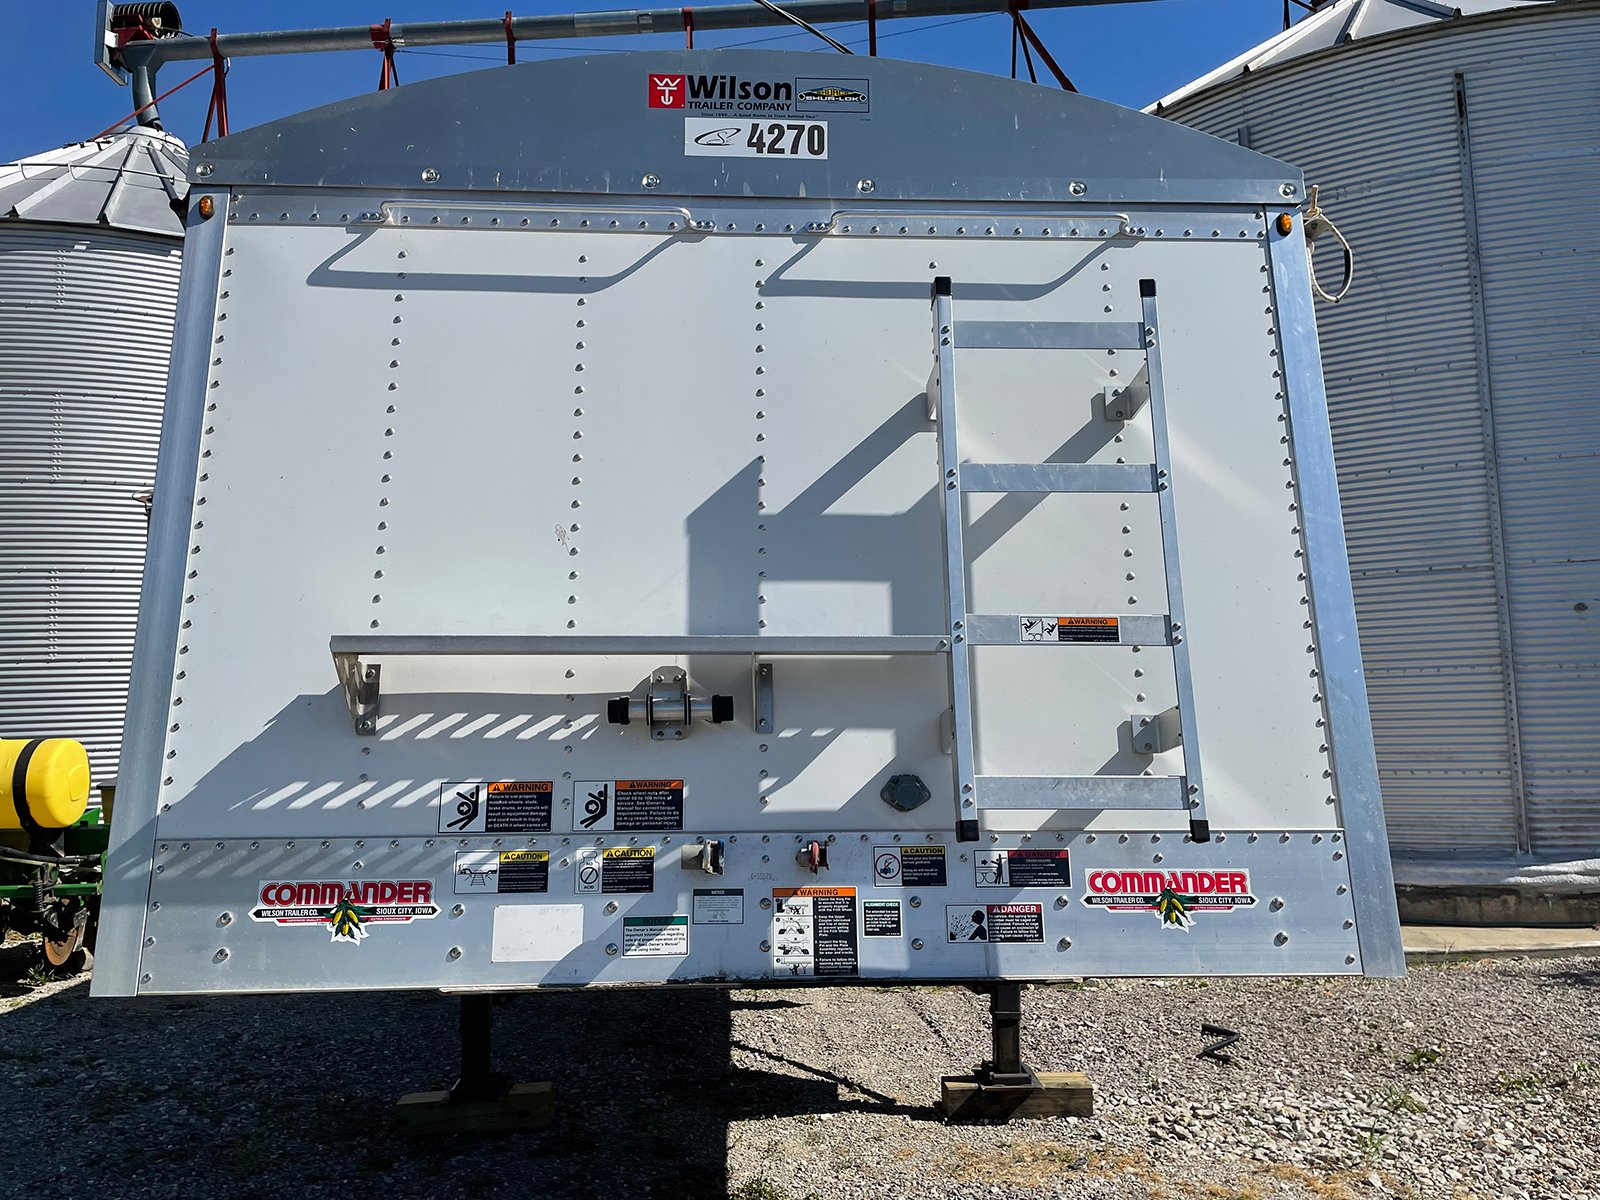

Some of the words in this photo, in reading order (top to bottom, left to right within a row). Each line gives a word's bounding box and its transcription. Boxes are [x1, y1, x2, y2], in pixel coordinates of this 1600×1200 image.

[686, 75, 792, 101] Wilson
[688, 102, 733, 111] TRAILER
[737, 102, 792, 112] COMPANY
[747, 123, 825, 155] 4270
[261, 881, 432, 906] COMMANDER
[1089, 872, 1248, 894] COMMANDER
